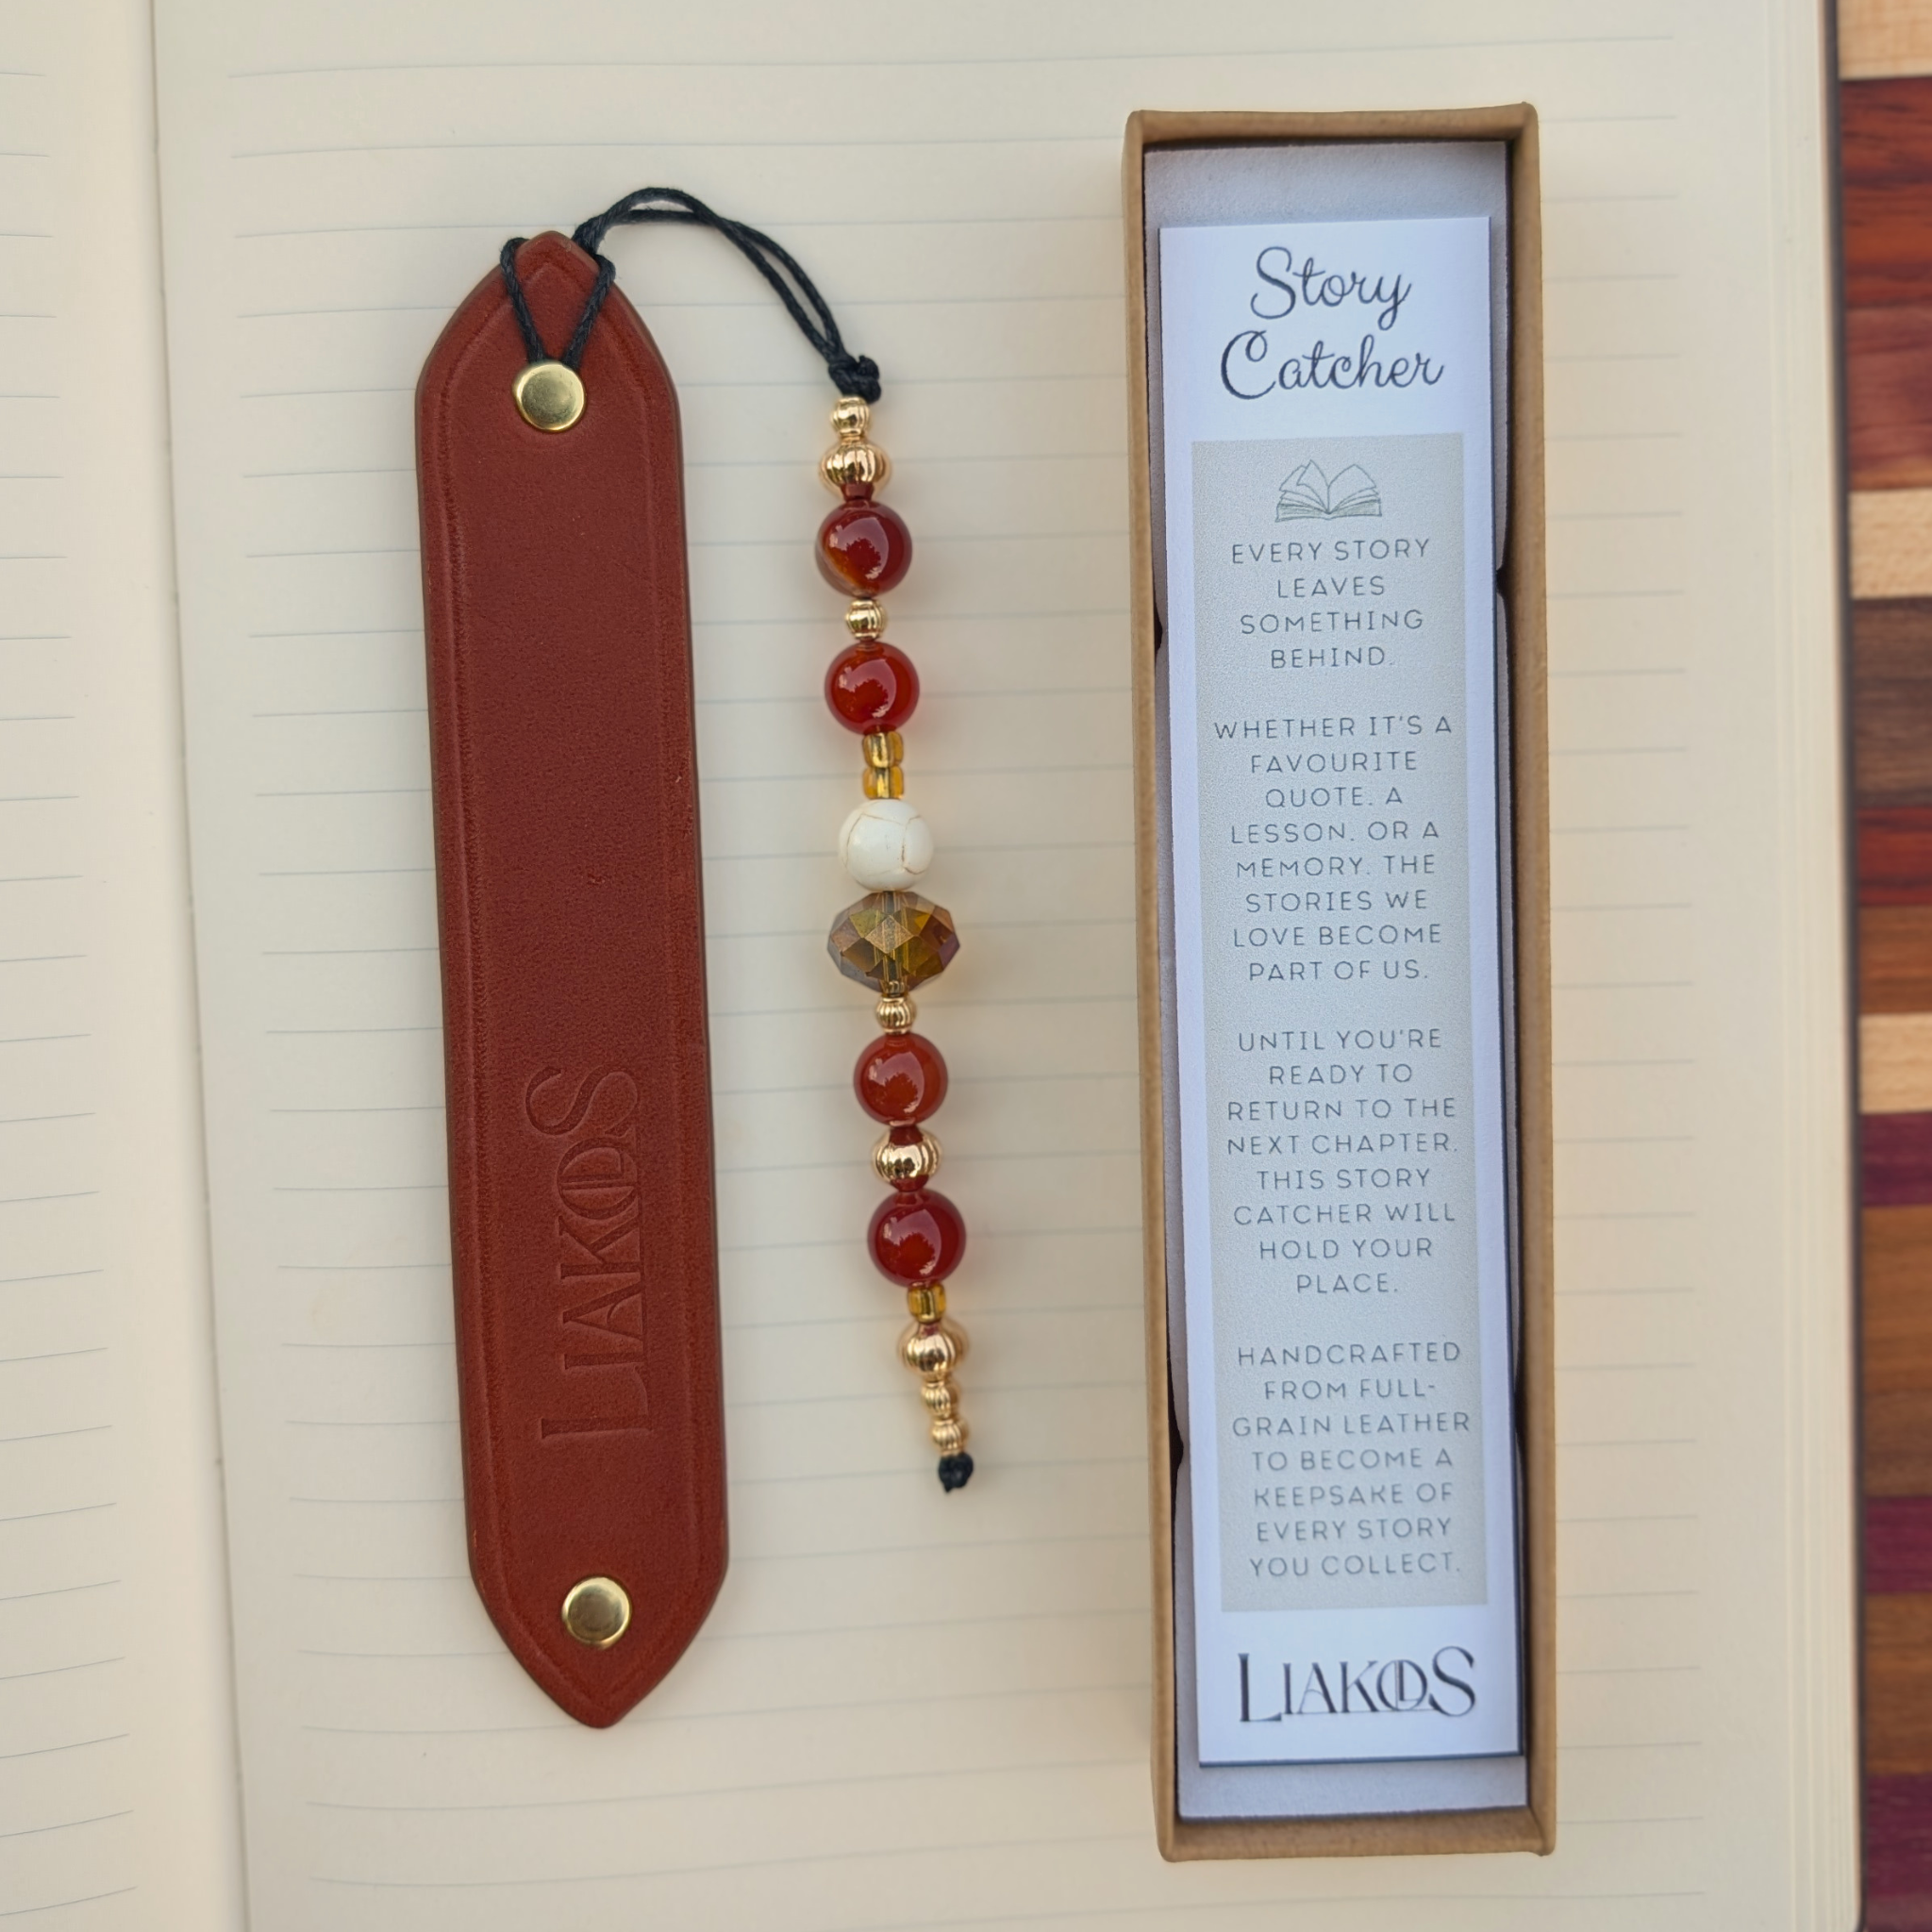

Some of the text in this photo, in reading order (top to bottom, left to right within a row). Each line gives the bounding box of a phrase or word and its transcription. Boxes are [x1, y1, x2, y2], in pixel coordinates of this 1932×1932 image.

[1247, 245, 1413, 331] Story
[1220, 329, 1445, 401] Catcher
[1231, 538, 1430, 565] EVERY STORY
[1276, 575, 1386, 599] LEAVES
[1240, 609, 1424, 636] SOMETHING
[1270, 645, 1395, 669] BEHIND.
[1213, 714, 1452, 740] WHETHER IT'S A
[1251, 750, 1417, 774] FAVOURITE
[1385, 787, 1403, 806] A
[1367, 821, 1408, 841] OR
[1422, 821, 1440, 839] A
[1383, 854, 1436, 874] THE
[1245, 889, 1427, 913] STORIES WE
[1233, 924, 1441, 948] LOVE BECOME
[1249, 958, 1428, 982] PART OF US.
[1238, 1028, 1441, 1052] UNTIL YOU'RE
[1269, 1063, 1413, 1085] READY TO
[1227, 1097, 1457, 1122] RETURN TO THE
[1227, 1134, 1300, 1156] NEXT
[1257, 1167, 1431, 1191] THIS STORY
[1233, 1202, 1456, 1225] CATCHER WILL
[1259, 1237, 1433, 1260] HOLD YOUR
[1296, 1273, 1398, 1294] PLACE.
[1238, 1341, 1461, 1366] HANDCRAFTED
[1263, 1377, 1436, 1401] FROM FULL-
[1232, 1411, 1471, 1438] GRAIN LEATHER
[1252, 1447, 1454, 1472] TO BECOME A
[1254, 1482, 1454, 1507] KEEPSAKE OF
[1257, 1516, 1452, 1542] EVERY STORY
[1248, 1551, 1461, 1577] YOU COLLECT.
